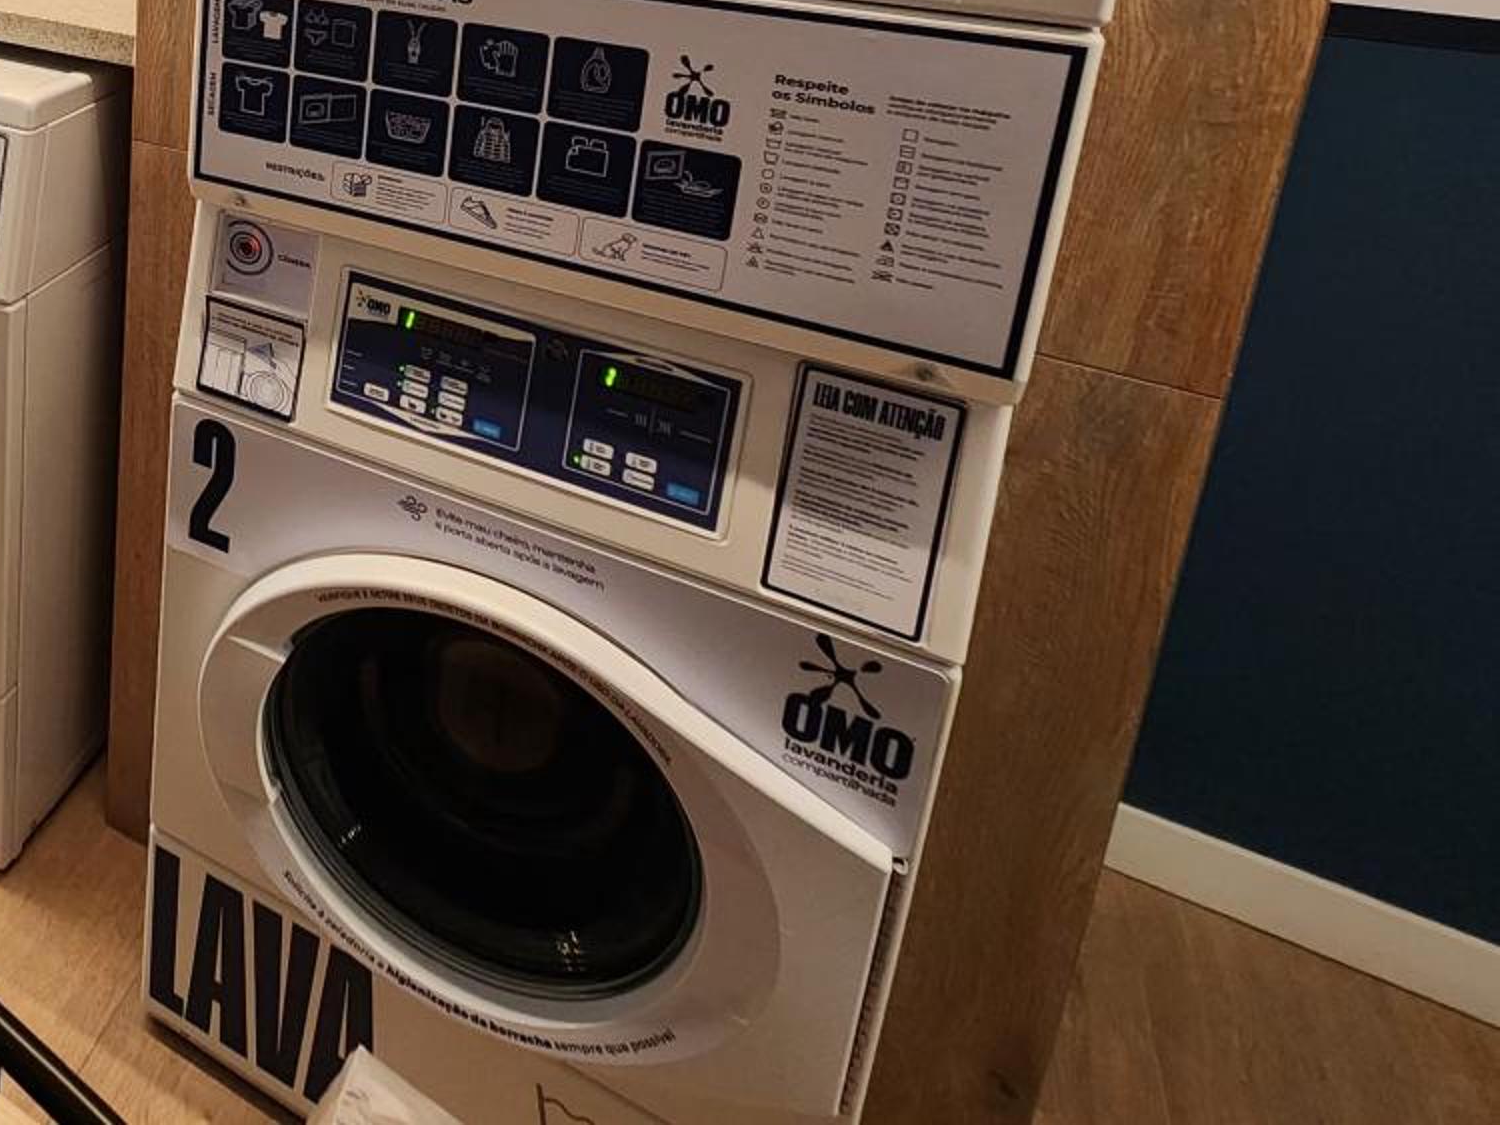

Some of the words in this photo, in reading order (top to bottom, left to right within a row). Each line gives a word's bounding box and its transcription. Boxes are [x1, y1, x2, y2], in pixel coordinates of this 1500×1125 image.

[665, 90, 731, 127] OMO
[771, 92, 792, 104] os
[795, 91, 876, 116] Símbolos
[774, 72, 850, 97] Respeite
[813, 382, 840, 412] LEIA
[843, 390, 877, 422] COM
[879, 405, 946, 442] ATENÇÃO
[189, 418, 236, 554] 2
[781, 691, 915, 780] OMO
[783, 736, 898, 796] lavanderia
[150, 843, 373, 1105] LAVA
[489, 1019, 553, 1051] borracha
[554, 1040, 603, 1056] sempre
[604, 1042, 630, 1057] que
